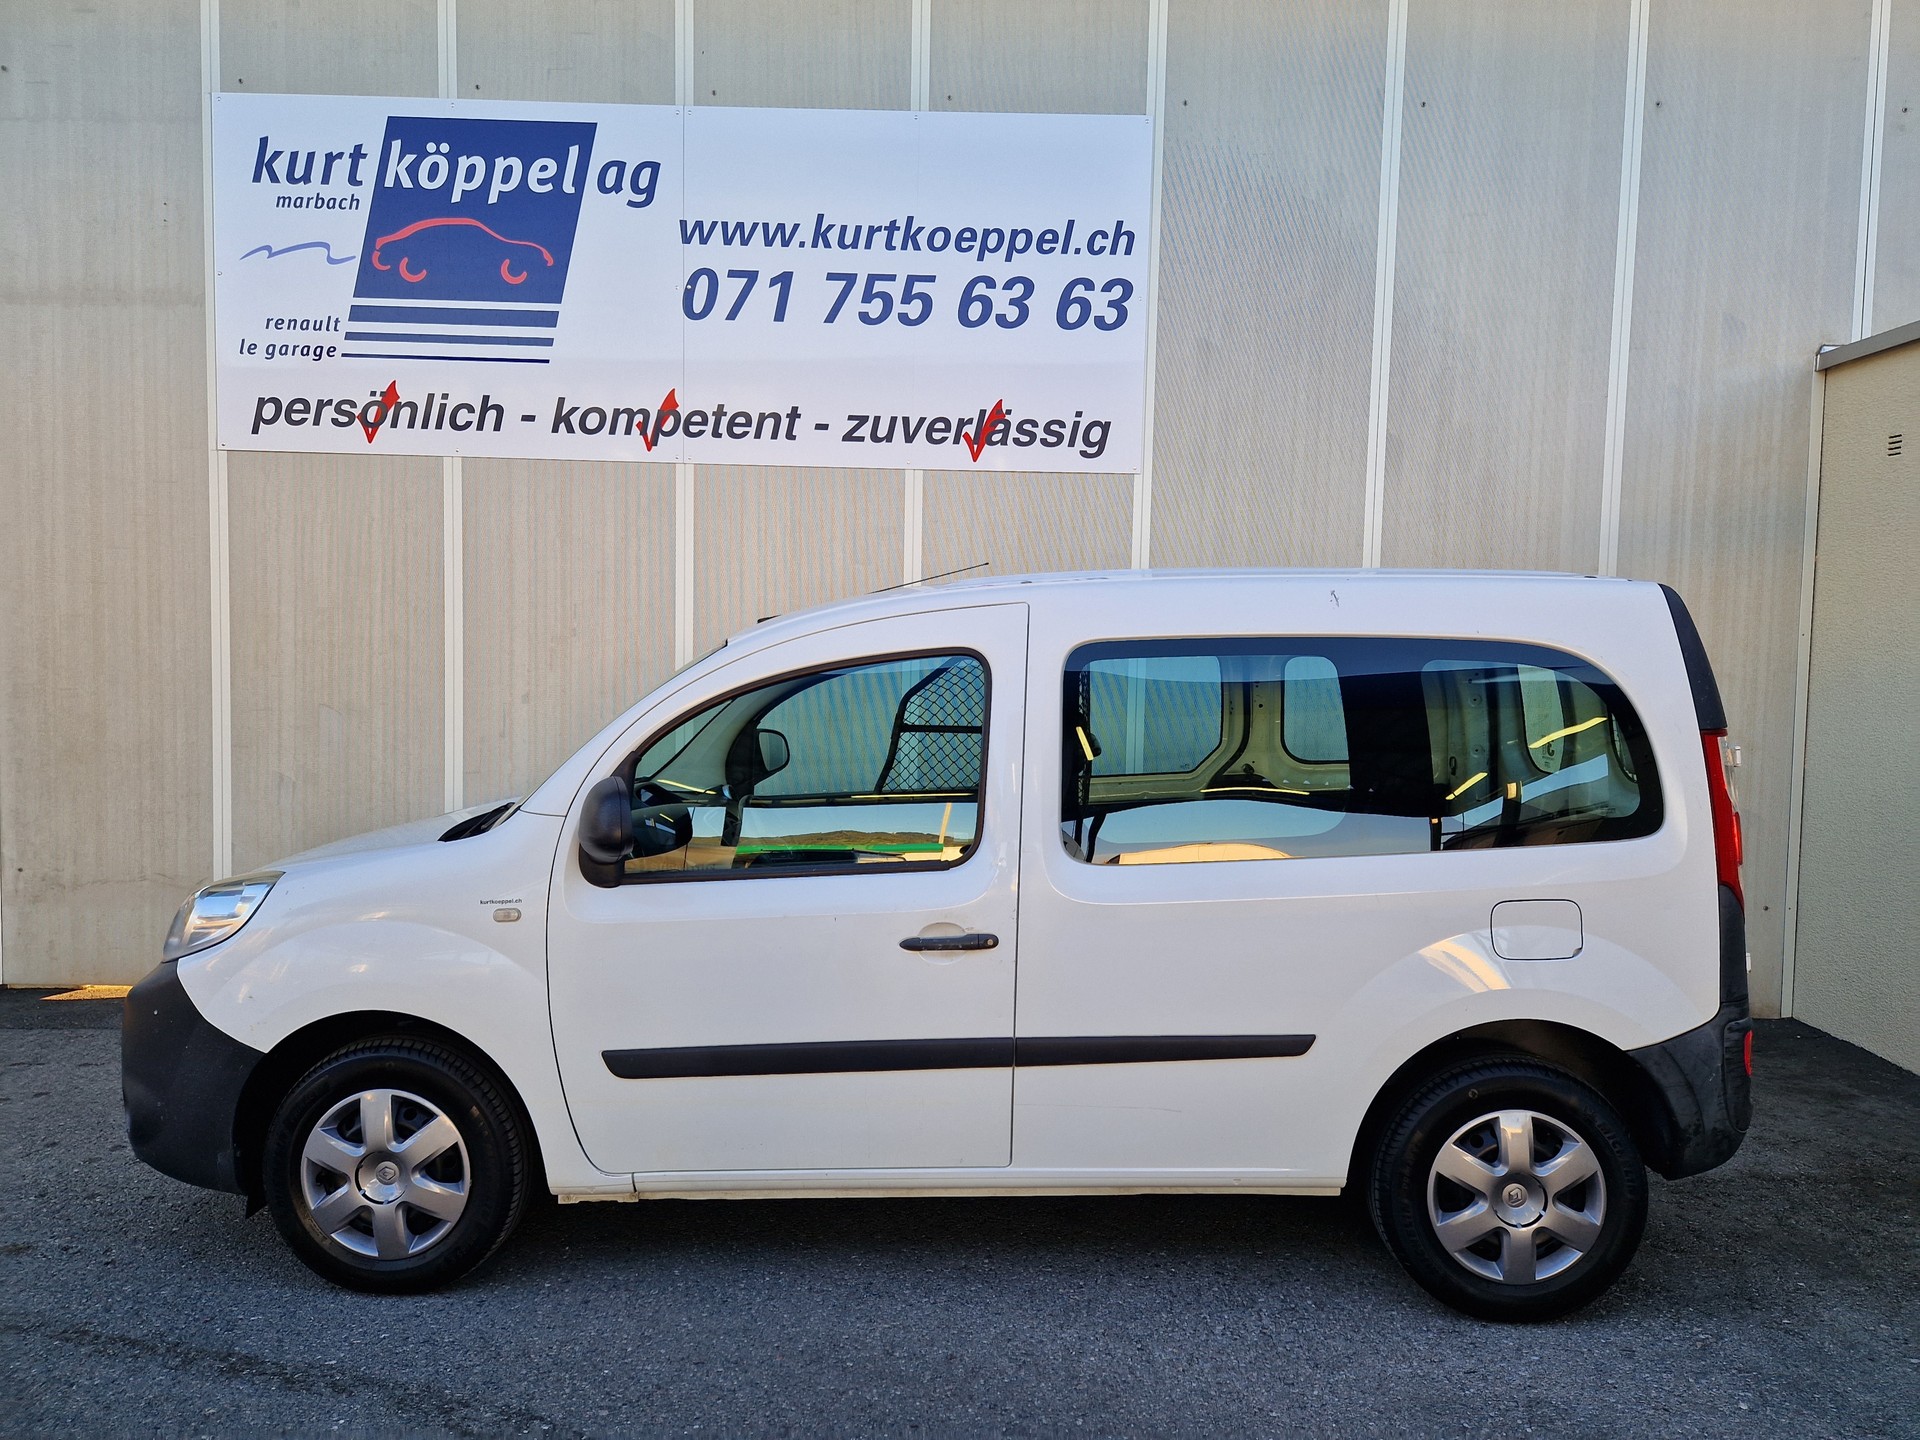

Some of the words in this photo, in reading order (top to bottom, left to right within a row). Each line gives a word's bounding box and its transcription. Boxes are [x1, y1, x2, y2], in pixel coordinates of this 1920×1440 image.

[252, 136, 368, 186] kurt
[383, 139, 580, 204] köppel
[596, 159, 661, 208] ag
[275, 192, 361, 211] marbach
[679, 213, 1136, 262] www.kurtkoeppel.ch
[265, 314, 341, 332] renault
[682, 267, 794, 322] 071
[823, 271, 937, 327] 755
[957, 275, 1035, 329] 63
[1055, 277, 1134, 331] 63
[239, 338, 258, 356] le
[265, 343, 337, 361] garage
[251, 391, 505, 434] persönlich
[551, 397, 801, 446] kompetent
[842, 409, 1111, 458] zuverlässig
